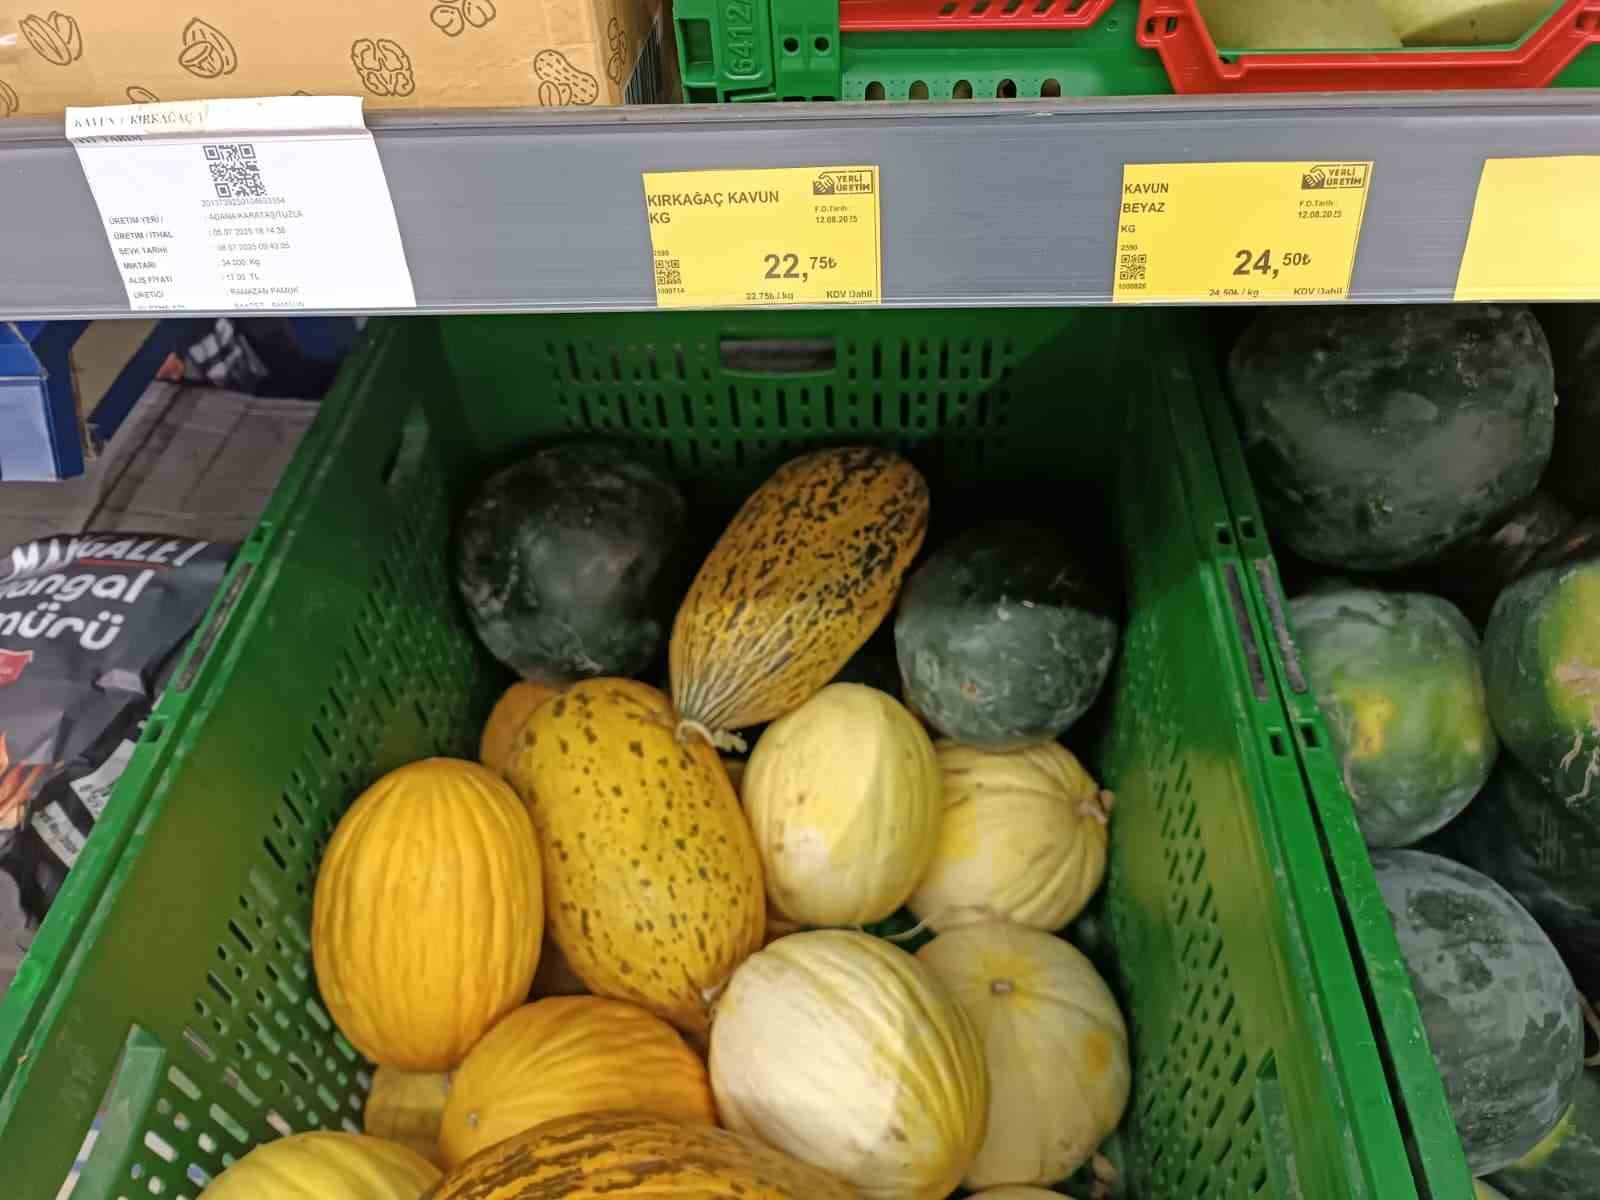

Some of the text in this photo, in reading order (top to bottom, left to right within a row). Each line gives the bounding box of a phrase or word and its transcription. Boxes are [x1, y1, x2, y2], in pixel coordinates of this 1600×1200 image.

[836, 173, 863, 183] YERLİ
[1124, 183, 1169, 194] KAVUN
[647, 190, 780, 207] KIRKAĞAÇ KAVUN
[1122, 202, 1165, 213] BEYAZ
[649, 212, 671, 224] KG
[1121, 224, 1136, 233] KG
